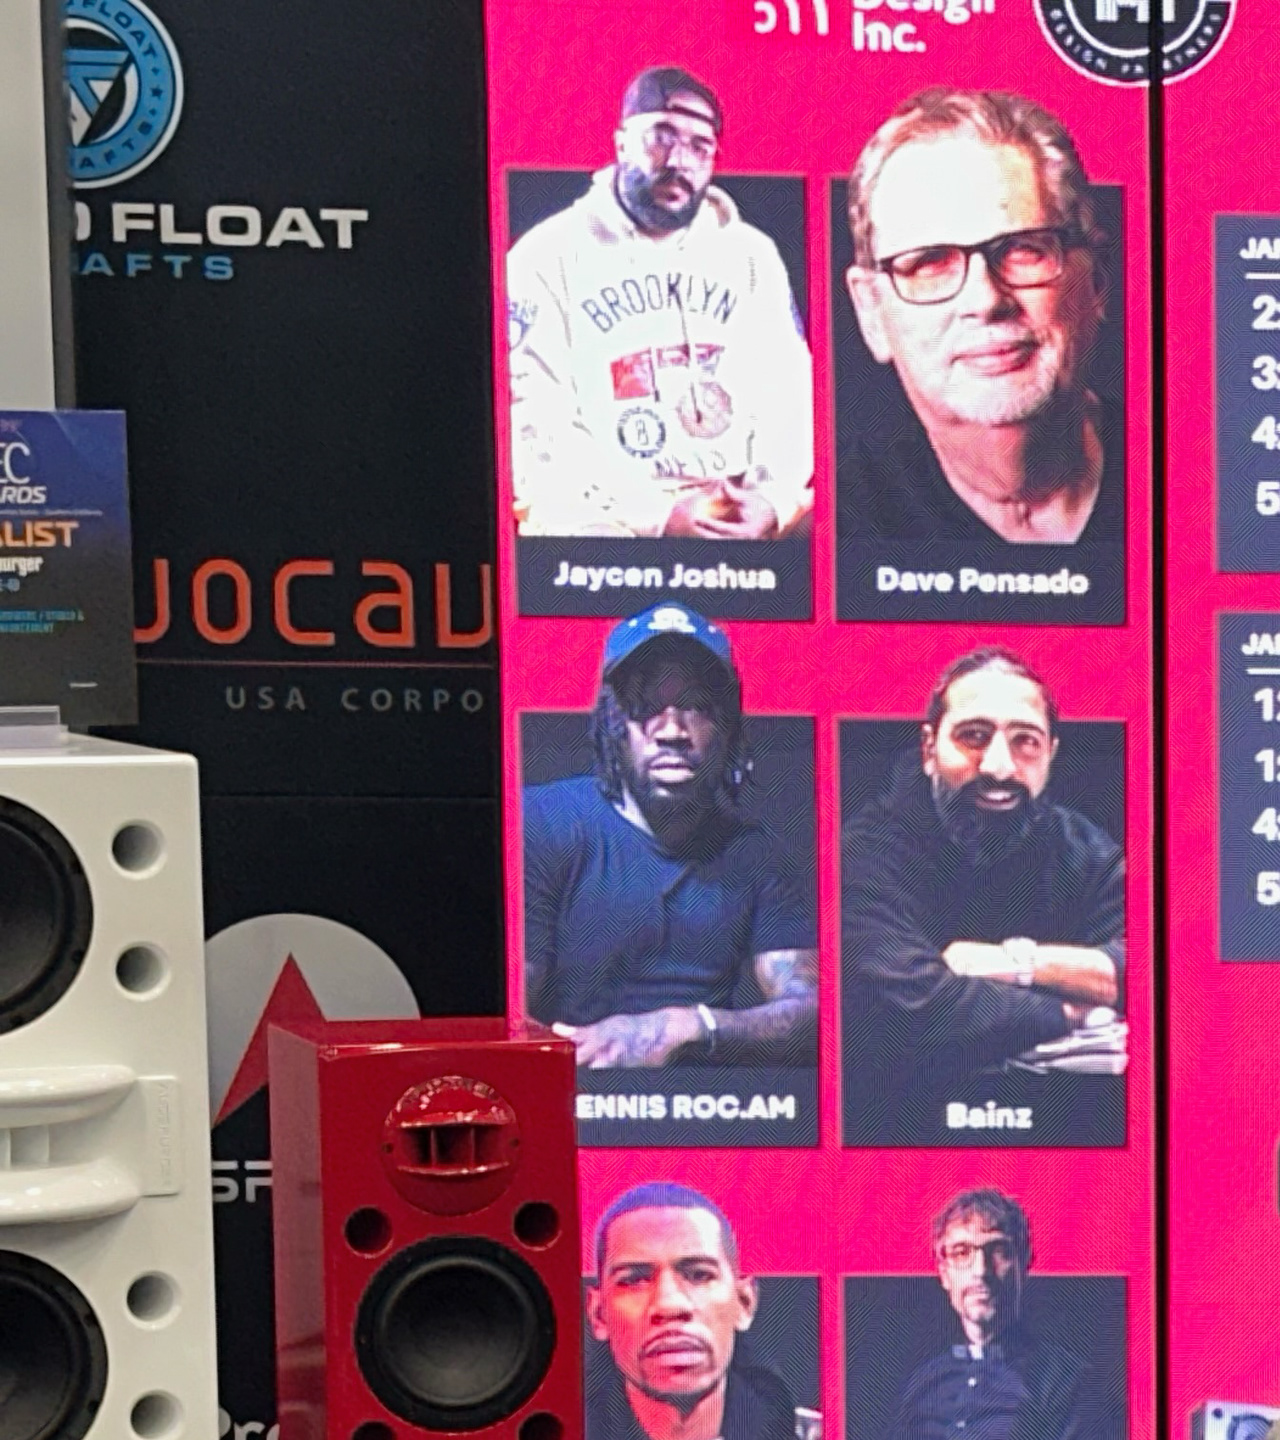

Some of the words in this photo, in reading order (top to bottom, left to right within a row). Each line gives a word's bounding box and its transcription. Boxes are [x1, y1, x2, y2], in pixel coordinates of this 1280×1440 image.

[853, 8, 926, 52] Inc.
[111, 202, 369, 249] FLOAT
[581, 271, 738, 334] BROOKLYN
[668, 562, 776, 590] Joshua
[877, 566, 955, 592] Dave
[959, 567, 1090, 595] Pensado
[225, 685, 307, 712] USA
[575, 1095, 666, 1121] ENNIS
[946, 1100, 1033, 1129] Bainz
